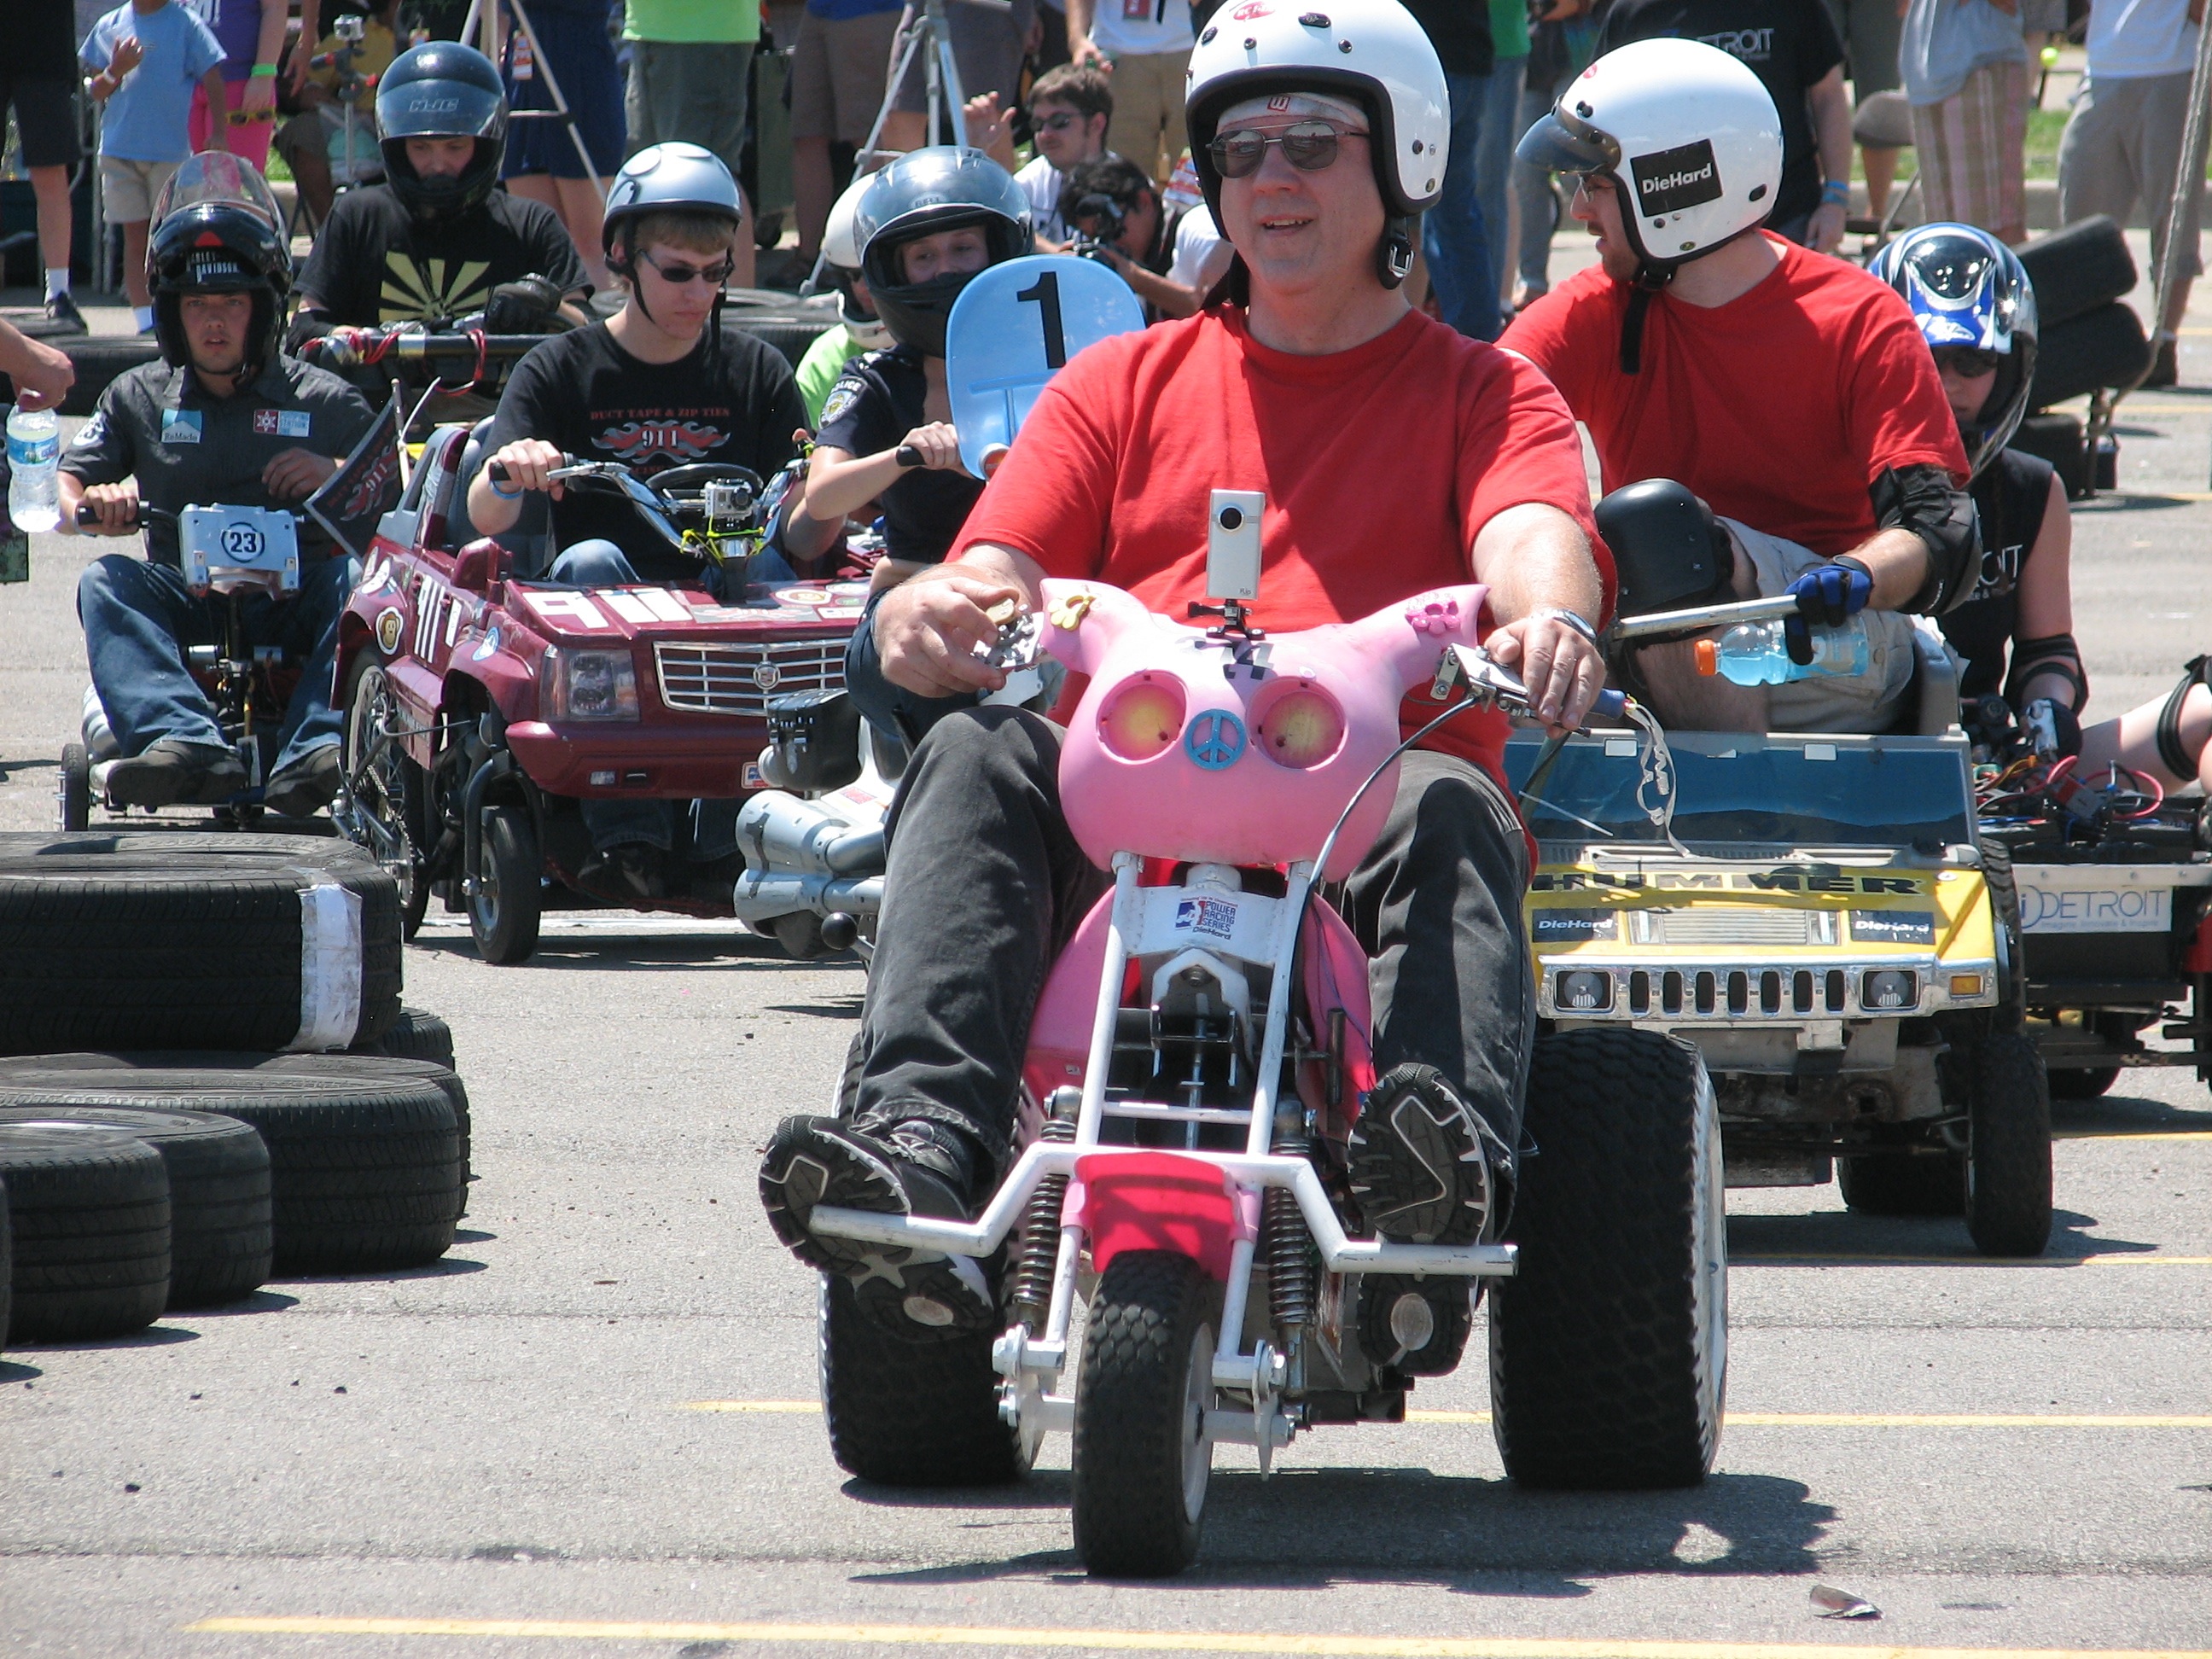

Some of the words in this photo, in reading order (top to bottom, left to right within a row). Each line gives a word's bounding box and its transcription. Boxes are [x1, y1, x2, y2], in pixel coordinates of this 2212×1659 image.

[1697, 28, 1774, 54] TROIT
[1642, 162, 1712, 195] DieHard
[1016, 271, 1067, 370] 1
[627, 408, 661, 418] TAPE
[678, 408, 698, 416] ZIP
[642, 429, 678, 448] 911
[230, 532, 257, 553] 23
[522, 587, 694, 628] 911
[1531, 872, 1921, 894] HUMMER
[1203, 910, 1235, 925] RACING
[1206, 901, 1237, 917] POWER
[1202, 918, 1231, 933] SERIES
[1539, 919, 1613, 929] DieHard
[1854, 920, 1930, 932] DieHard
[1192, 927, 1231, 940] DieHard
